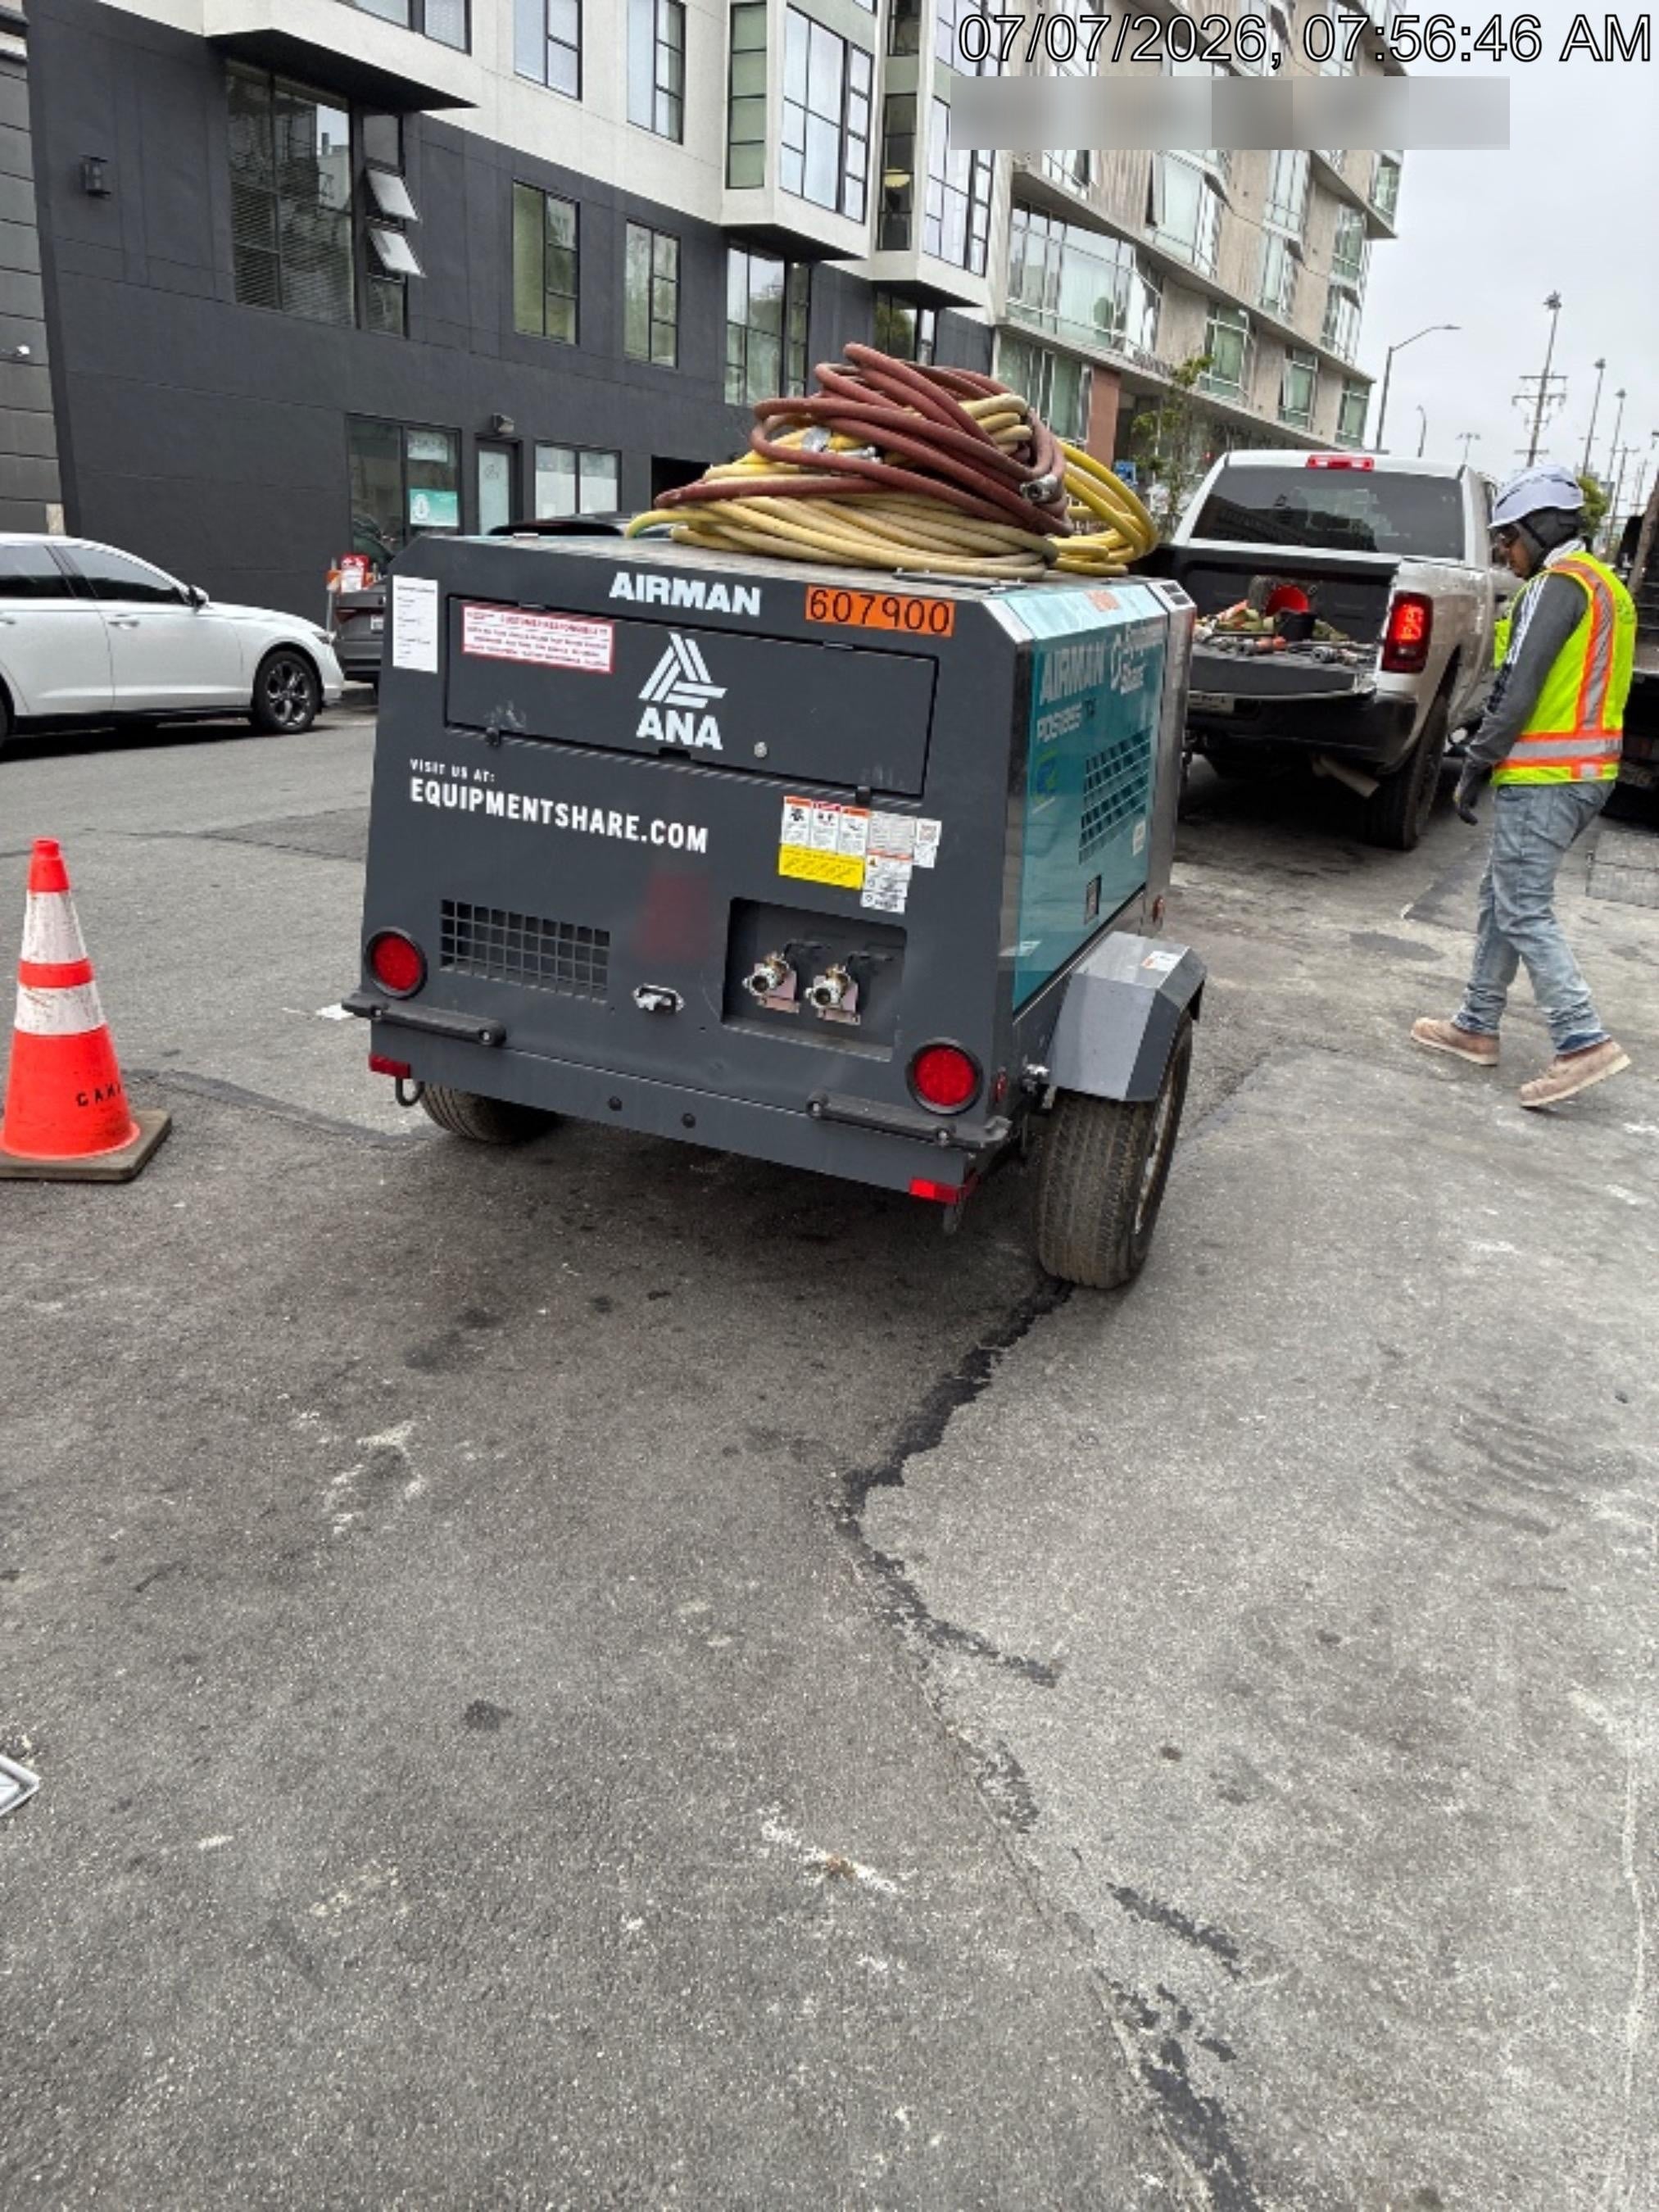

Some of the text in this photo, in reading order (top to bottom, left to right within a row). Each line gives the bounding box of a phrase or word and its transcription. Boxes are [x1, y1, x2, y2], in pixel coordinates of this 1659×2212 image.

[609, 572, 761, 617] AIRMAN
[809, 589, 951, 633] 607900
[636, 706, 723, 751] ANA
[410, 759, 496, 782] VISIT US AT:
[410, 777, 709, 853] EQUIPMENTSHARE.COM
